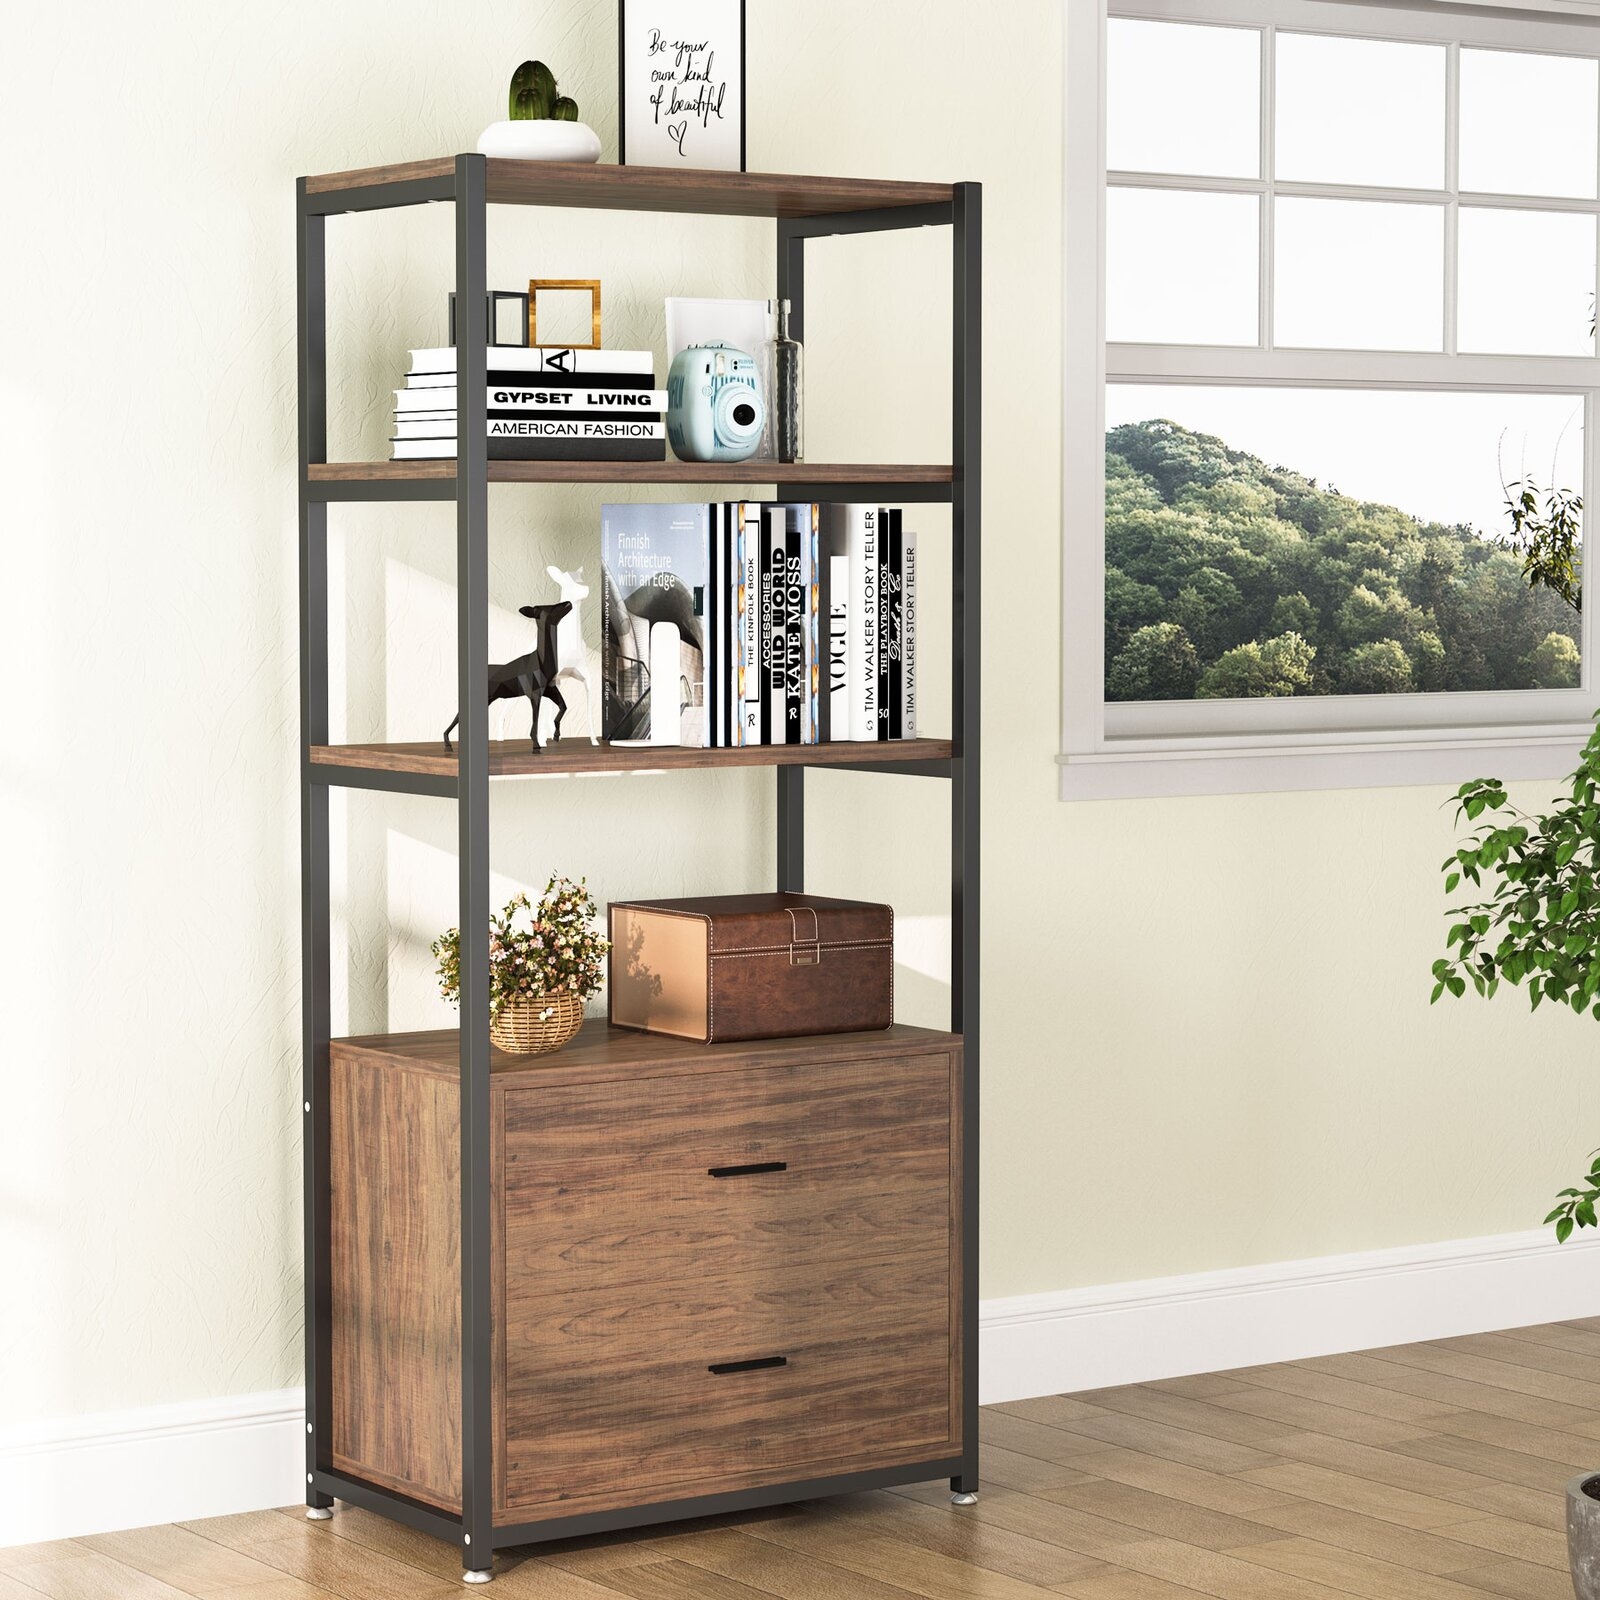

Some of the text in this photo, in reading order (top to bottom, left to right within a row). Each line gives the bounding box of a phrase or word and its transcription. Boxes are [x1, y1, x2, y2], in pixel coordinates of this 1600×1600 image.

[648, 28, 667, 56] Be
[651, 51, 714, 85] own kind
[650, 82, 726, 128] of beautiful
[545, 349, 570, 373] A
[493, 391, 651, 406] GYPSET LIVING
[491, 422, 653, 436] AMERICAN FASHION
[618, 533, 650, 550] Finnish
[618, 552, 672, 568] Architecture
[617, 571, 675, 591] with an Edge
[762, 572, 771, 669] ACCESSORIES
[772, 547, 785, 689] WILD WORLD
[787, 556, 801, 699] KATE MOSS
[864, 511, 874, 712] TIM WALKER STORY TELLER
[880, 563, 888, 675] THE PLAYBOY BOOK
[906, 547, 915, 714] TIM WALKER STORY TELLER
[830, 603, 846, 692] VOGUE
[888, 611, 901, 661] Death
[878, 708, 889, 719] 50
